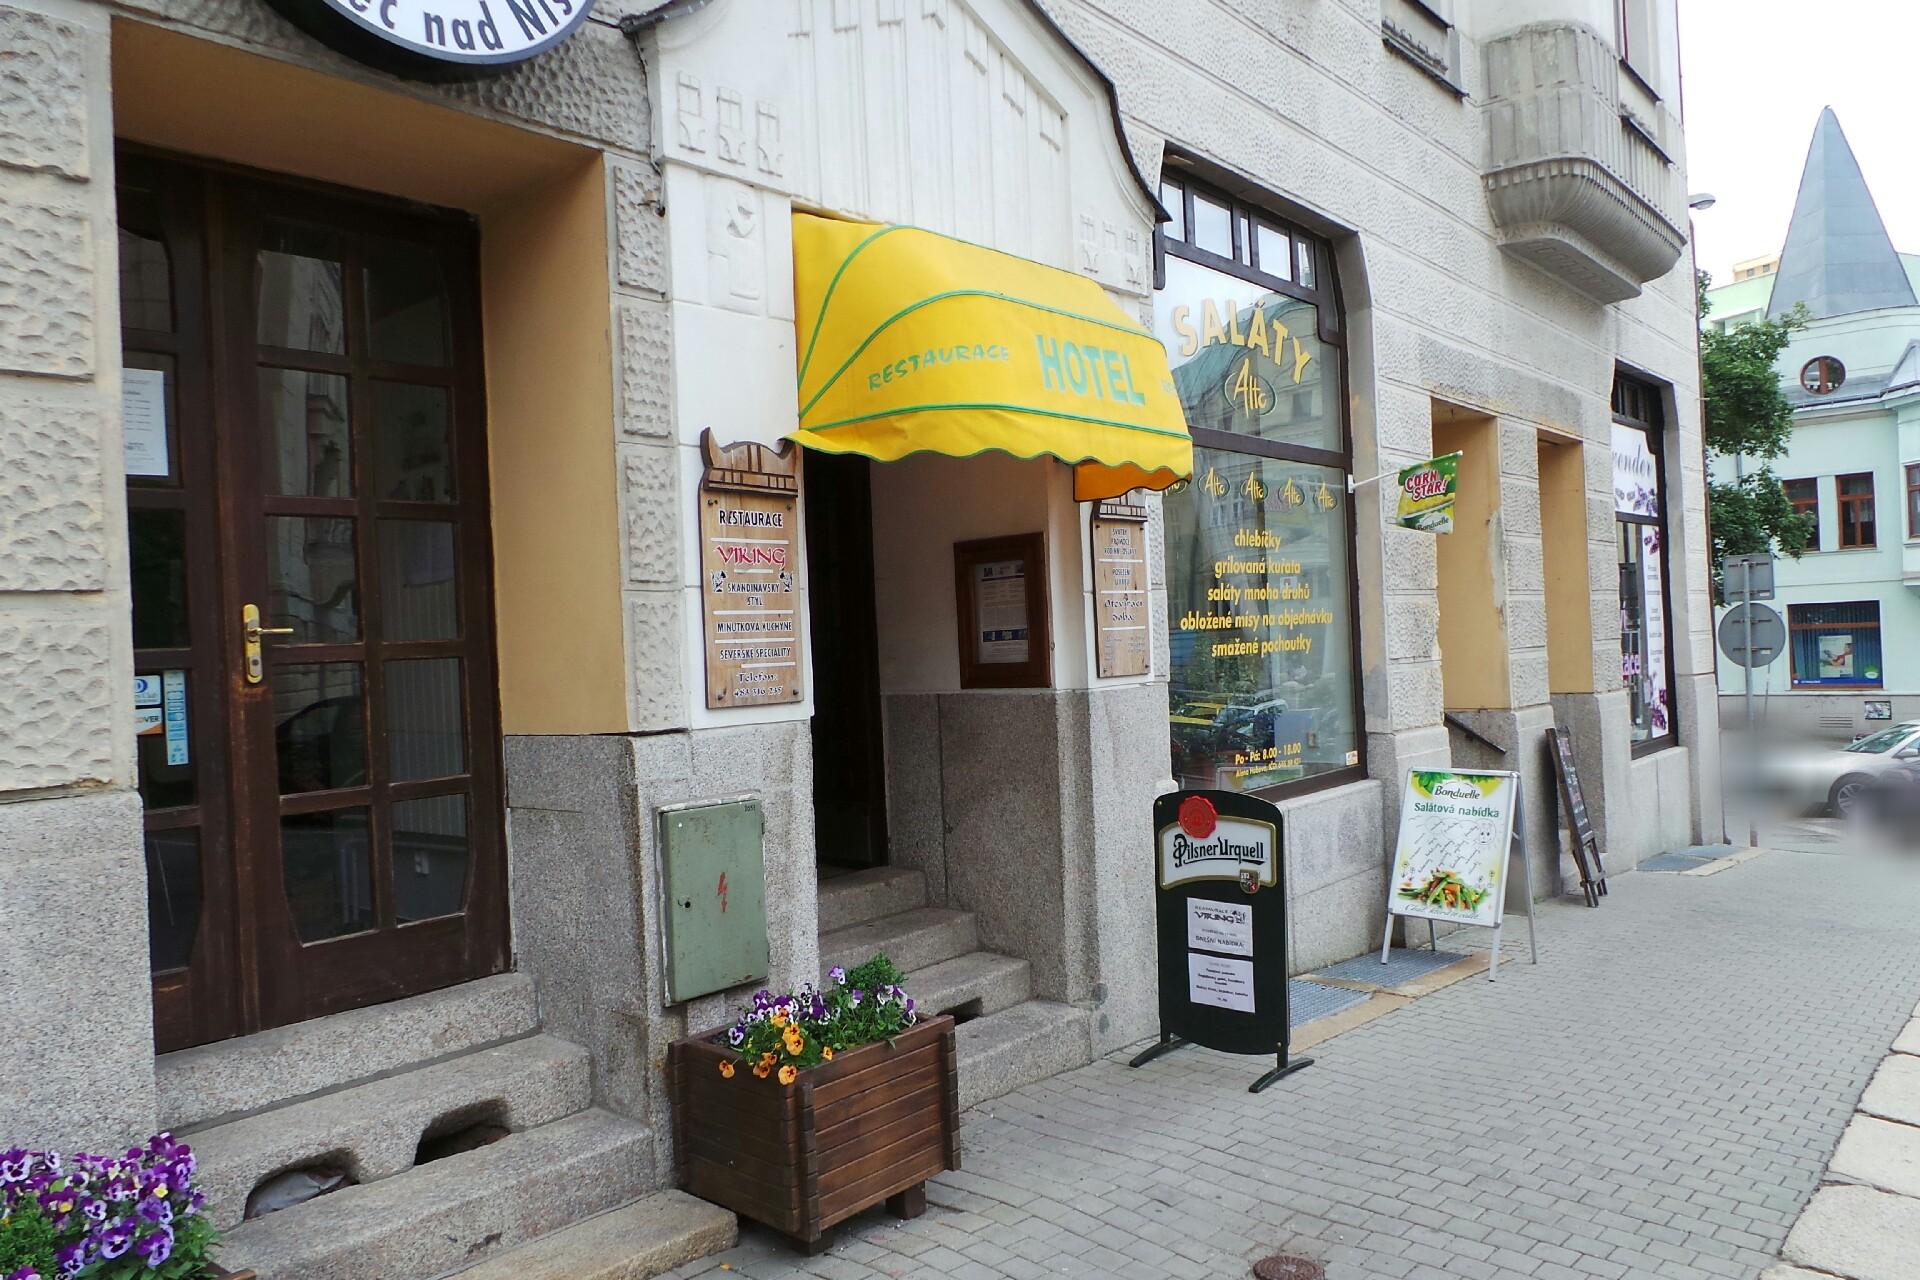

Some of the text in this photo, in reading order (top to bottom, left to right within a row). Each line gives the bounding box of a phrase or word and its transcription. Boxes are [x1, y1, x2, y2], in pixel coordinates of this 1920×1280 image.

[423, 0, 504, 50] nad
[1173, 297, 1312, 385] SALÁTY
[868, 334, 1146, 407] RESTAURACE HOTEL
[1405, 470, 1438, 491] CORN
[1412, 479, 1448, 500] STAR!
[719, 510, 783, 527] RESTAURACE
[1417, 516, 1449, 531] Bonduelle
[1234, 528, 1281, 552] chlebíčky
[716, 546, 785, 567] VIKING
[1214, 554, 1302, 579] grilovaná kuřata
[1207, 582, 1311, 606] saláty mnoha druhů
[1180, 607, 1334, 632] obložené mísy na objednávku
[756, 647, 791, 658] SPECIALITY
[1211, 633, 1313, 659] smažené pochoutky
[1235, 753, 1245, 765] Po
[1262, 748, 1278, 760] 8.00
[1434, 785, 1481, 800] Bonduelle
[1414, 802, 1500, 818] Salátová nabídka
[1172, 833, 1264, 868] Pilsner Urquell
